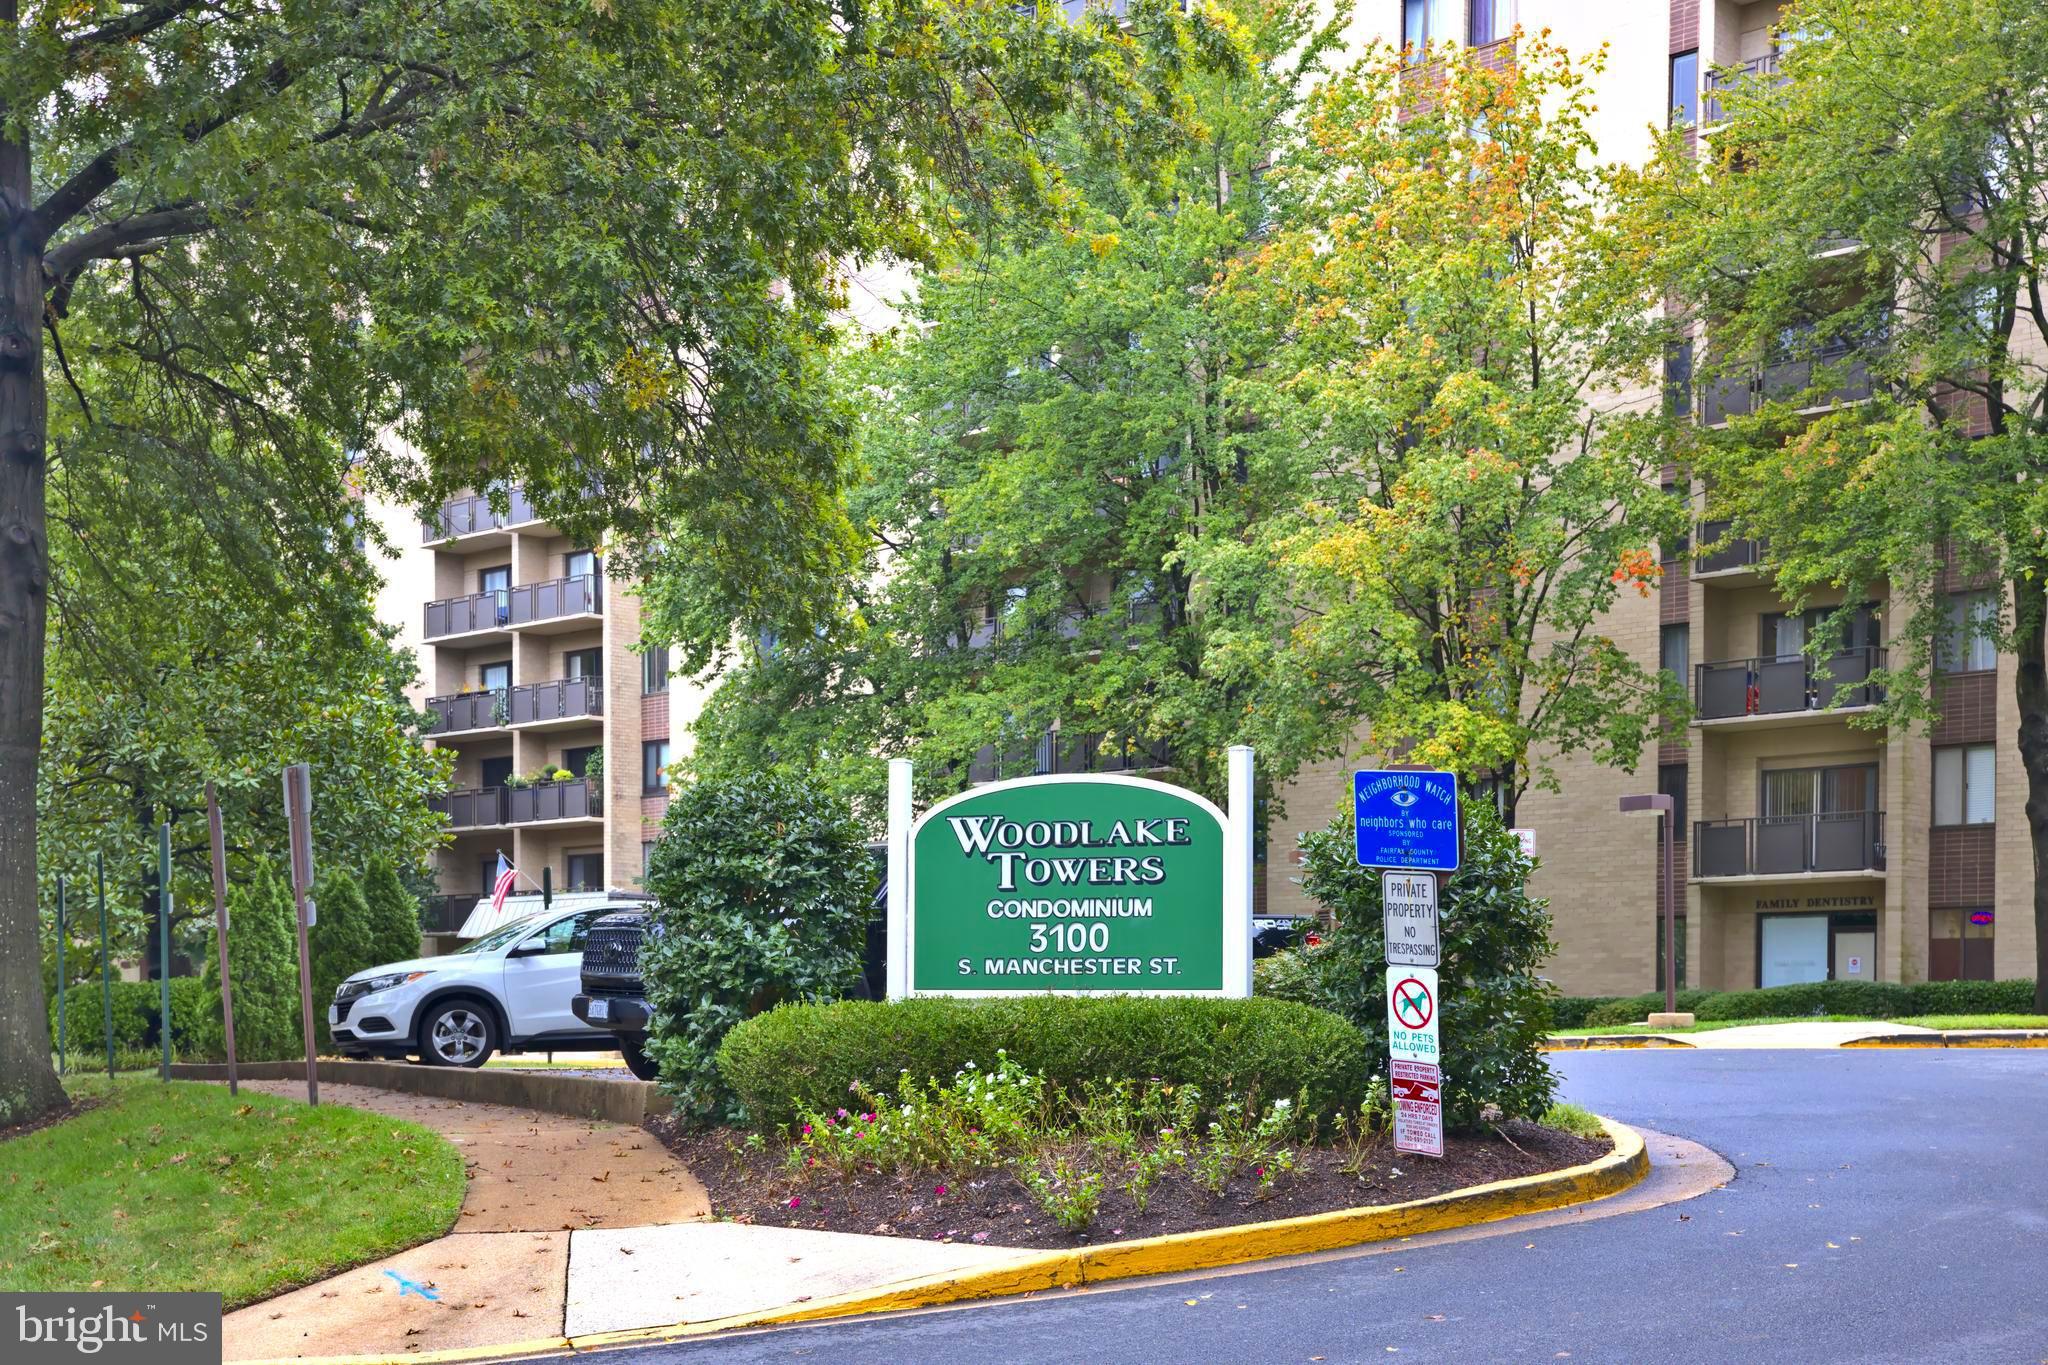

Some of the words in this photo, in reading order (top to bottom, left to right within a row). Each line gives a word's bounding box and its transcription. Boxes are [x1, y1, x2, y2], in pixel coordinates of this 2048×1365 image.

[1358, 775, 1420, 803] NEIGHBORHOOD
[1425, 780, 1452, 805] WATCH
[1360, 816, 1404, 831] neighbors
[1409, 817, 1427, 829] who
[1432, 820, 1452, 830] care
[946, 815, 1191, 857] WOODLAKE
[1388, 830, 1424, 838] SPONSORED
[1380, 847, 1404, 855] FAIRFAX
[1409, 848, 1434, 856] COUNTY
[1401, 857, 1439, 865] DEPARTMENT
[986, 852, 1166, 892] TOWERS
[1391, 882, 1428, 898] PRIVATE
[987, 898, 1153, 919] CONDOMINIUM
[1756, 899, 1799, 909] FAMILY
[1807, 896, 1874, 907] DENTISTRY
[1387, 903, 1433, 919] PROPERTY
[1028, 922, 1110, 953] 3100
[1404, 926, 1416, 938] NO
[1389, 942, 1436, 957] TRESPASSING
[958, 958, 978, 975] S.
[985, 958, 1142, 975] MANCHESTER
[1149, 957, 1182, 975] ST.
[1393, 1031, 1407, 1040] NO
[1411, 1033, 1434, 1043] PETS
[1392, 1041, 1437, 1054] ALLOWED
[1394, 1063, 1413, 1071] PRIVATE
[1414, 1065, 1435, 1074] PROPERTY
[1395, 1071, 1420, 1079] RESTRICTED
[1420, 1073, 1436, 1082] PARKING
[1414, 1102, 1437, 1116] ENFORCED
[1406, 1129, 1423, 1137] TOWED
[1424, 1131, 1436, 1139] CALL
